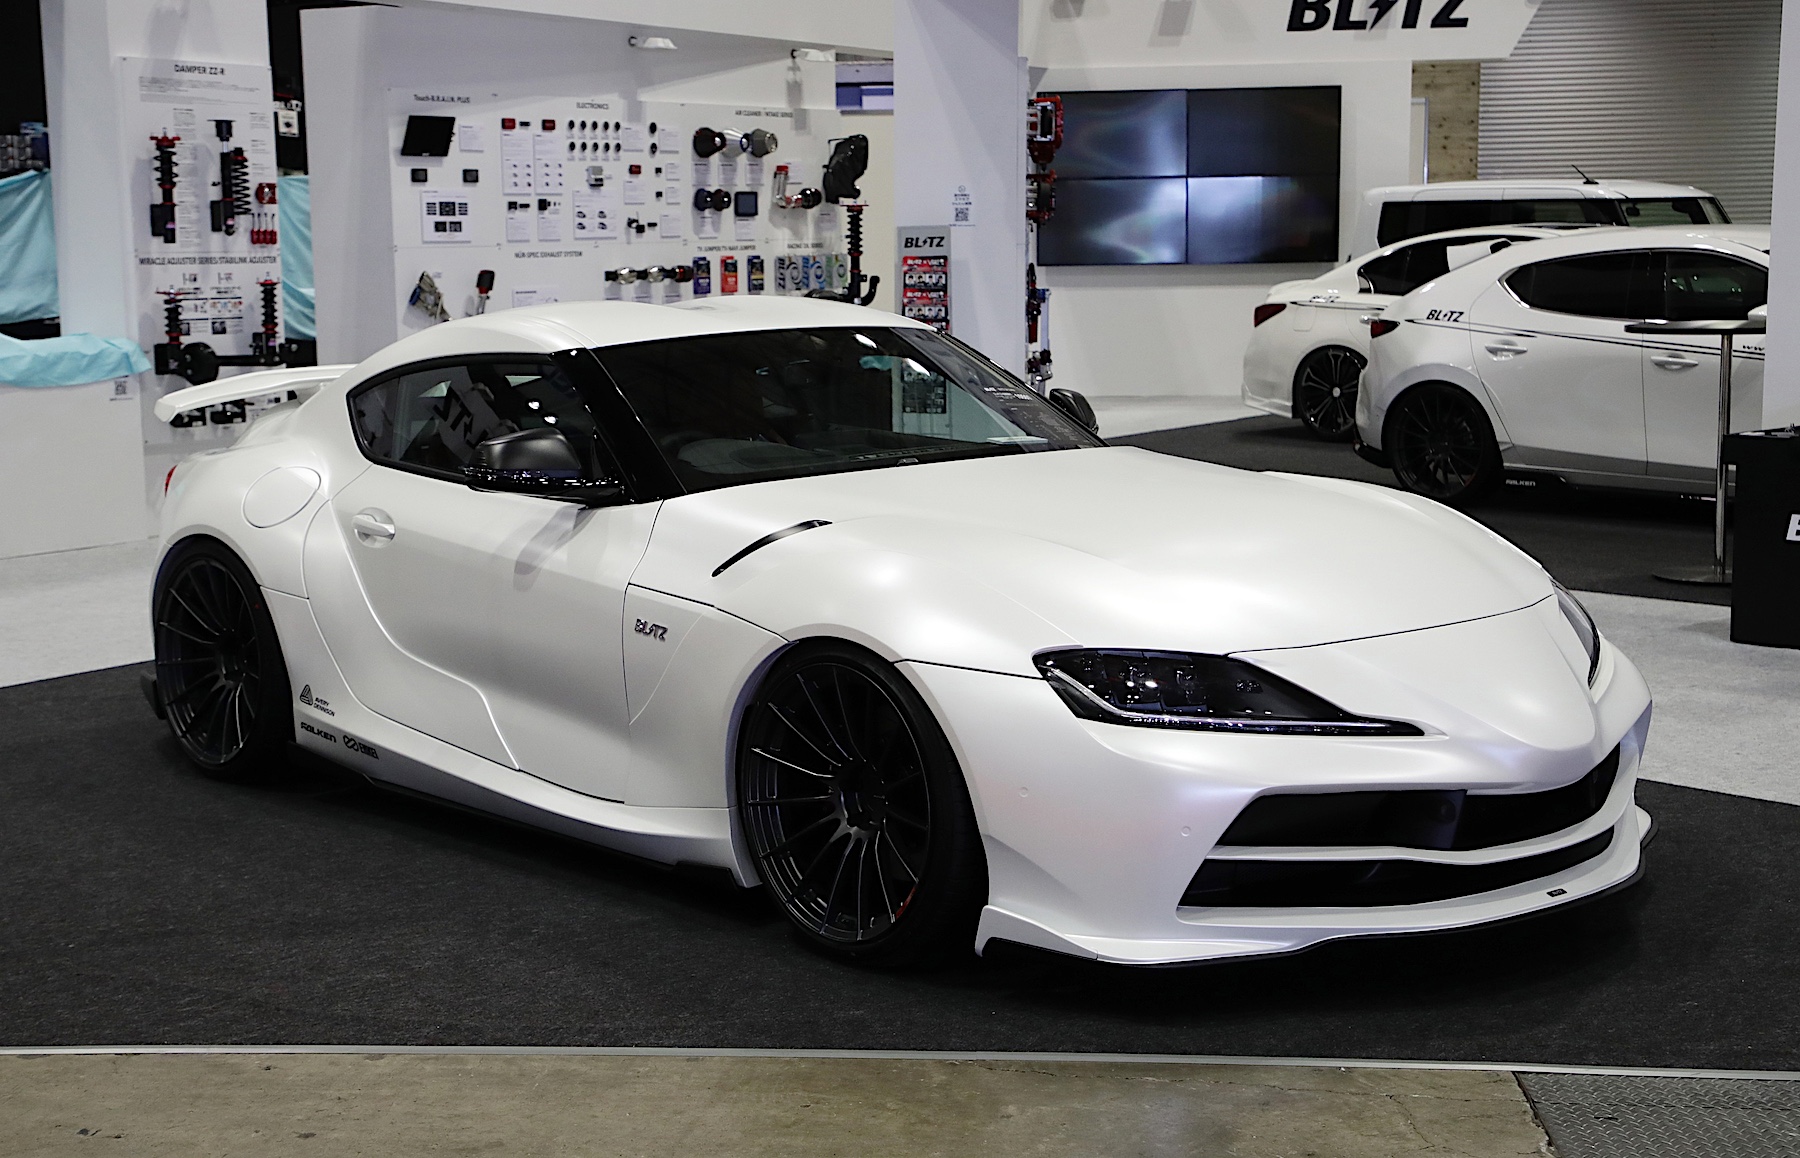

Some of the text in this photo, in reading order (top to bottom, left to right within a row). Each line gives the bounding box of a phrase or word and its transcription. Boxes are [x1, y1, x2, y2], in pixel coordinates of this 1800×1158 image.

[174, 64, 207, 75] DAMPER
[904, 236, 945, 248] BLITZ
[1426, 309, 1464, 323] BLITZ
[634, 618, 668, 641] BLITZ
[300, 721, 337, 743] FALKEN
